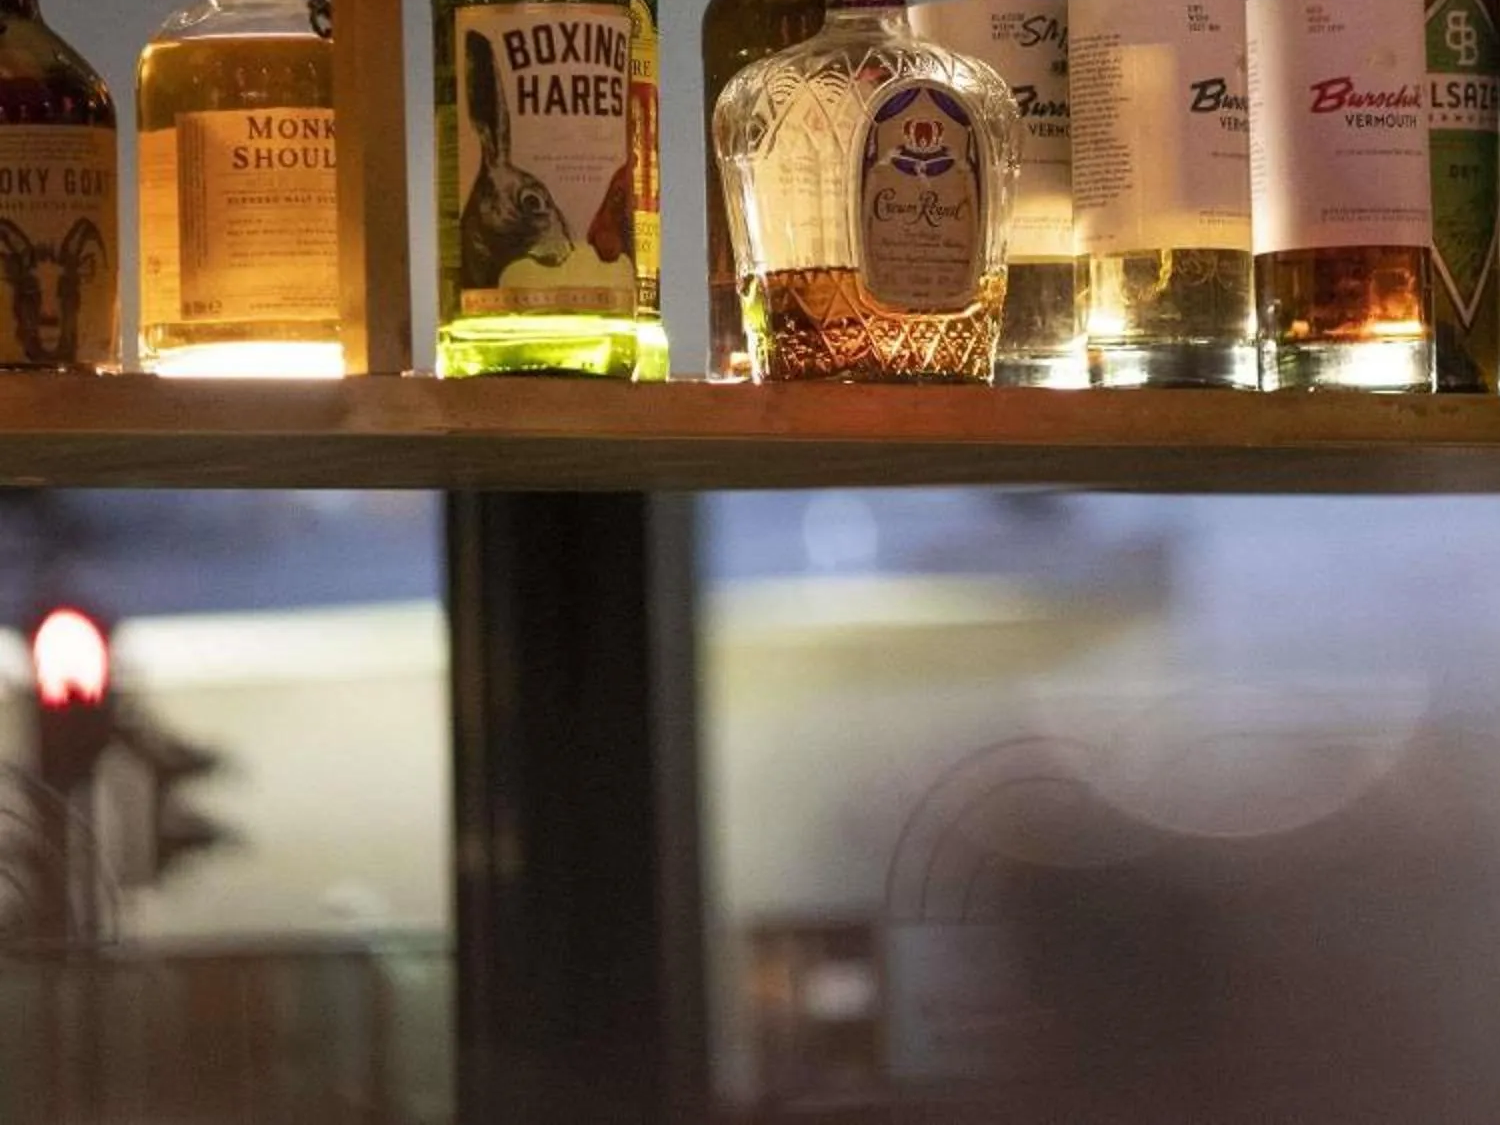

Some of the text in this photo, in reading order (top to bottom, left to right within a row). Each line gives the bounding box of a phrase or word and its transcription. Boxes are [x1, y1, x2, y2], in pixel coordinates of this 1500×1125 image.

[502, 21, 626, 74] BOXING
[517, 73, 624, 117] HARES
[1345, 114, 1419, 129] VERMOUTH
[232, 146, 338, 170] SHOUL
